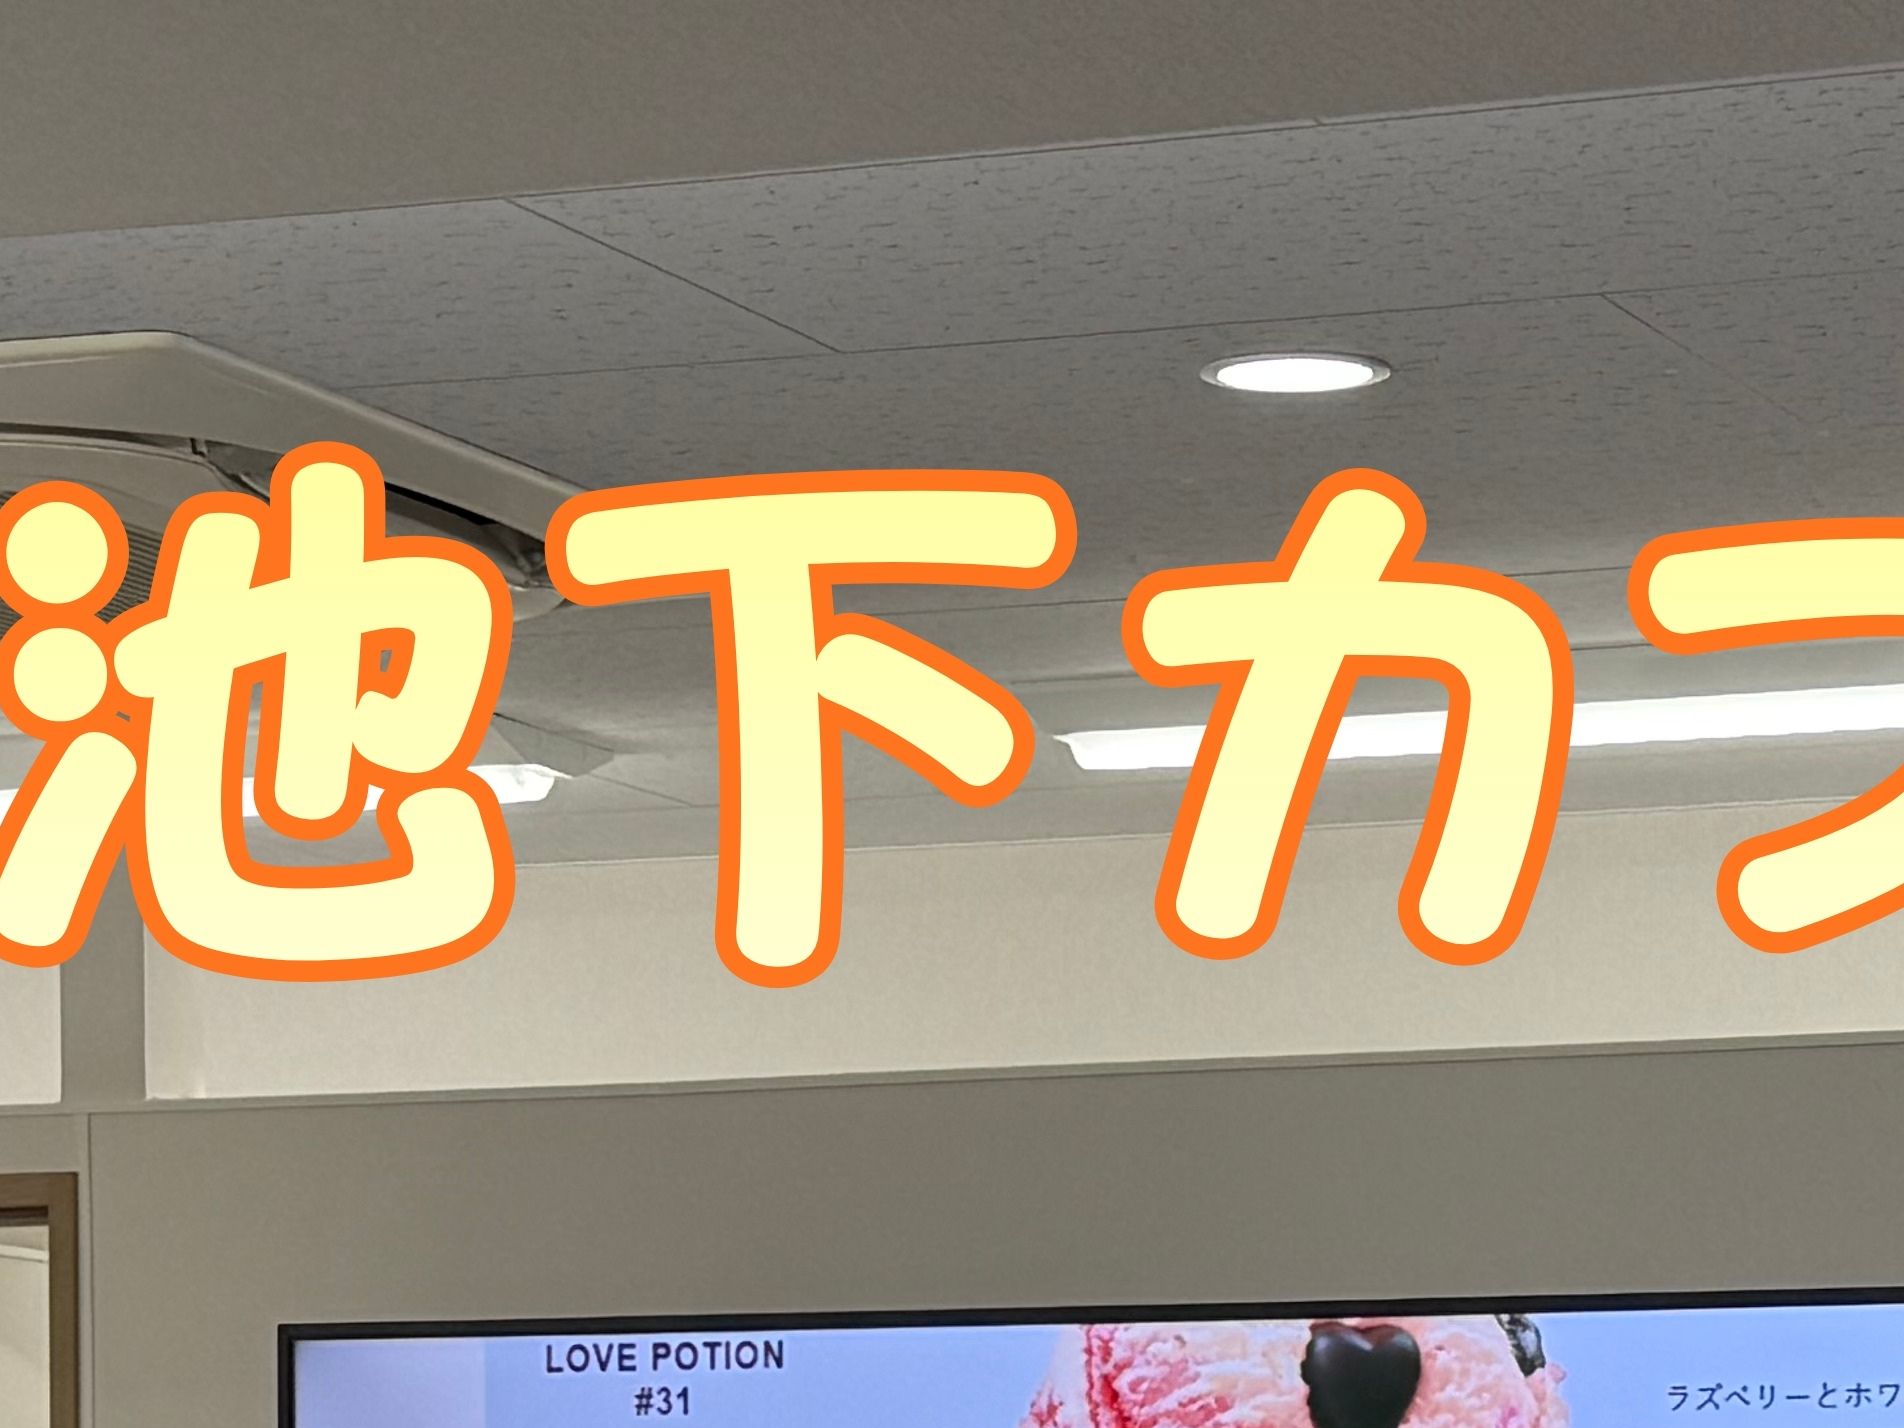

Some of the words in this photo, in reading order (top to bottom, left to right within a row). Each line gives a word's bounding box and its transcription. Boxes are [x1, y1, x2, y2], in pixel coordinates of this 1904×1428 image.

[544, 1341, 637, 1375] LOVE
[650, 1340, 785, 1372] POTION
[633, 1385, 690, 1418] #31
